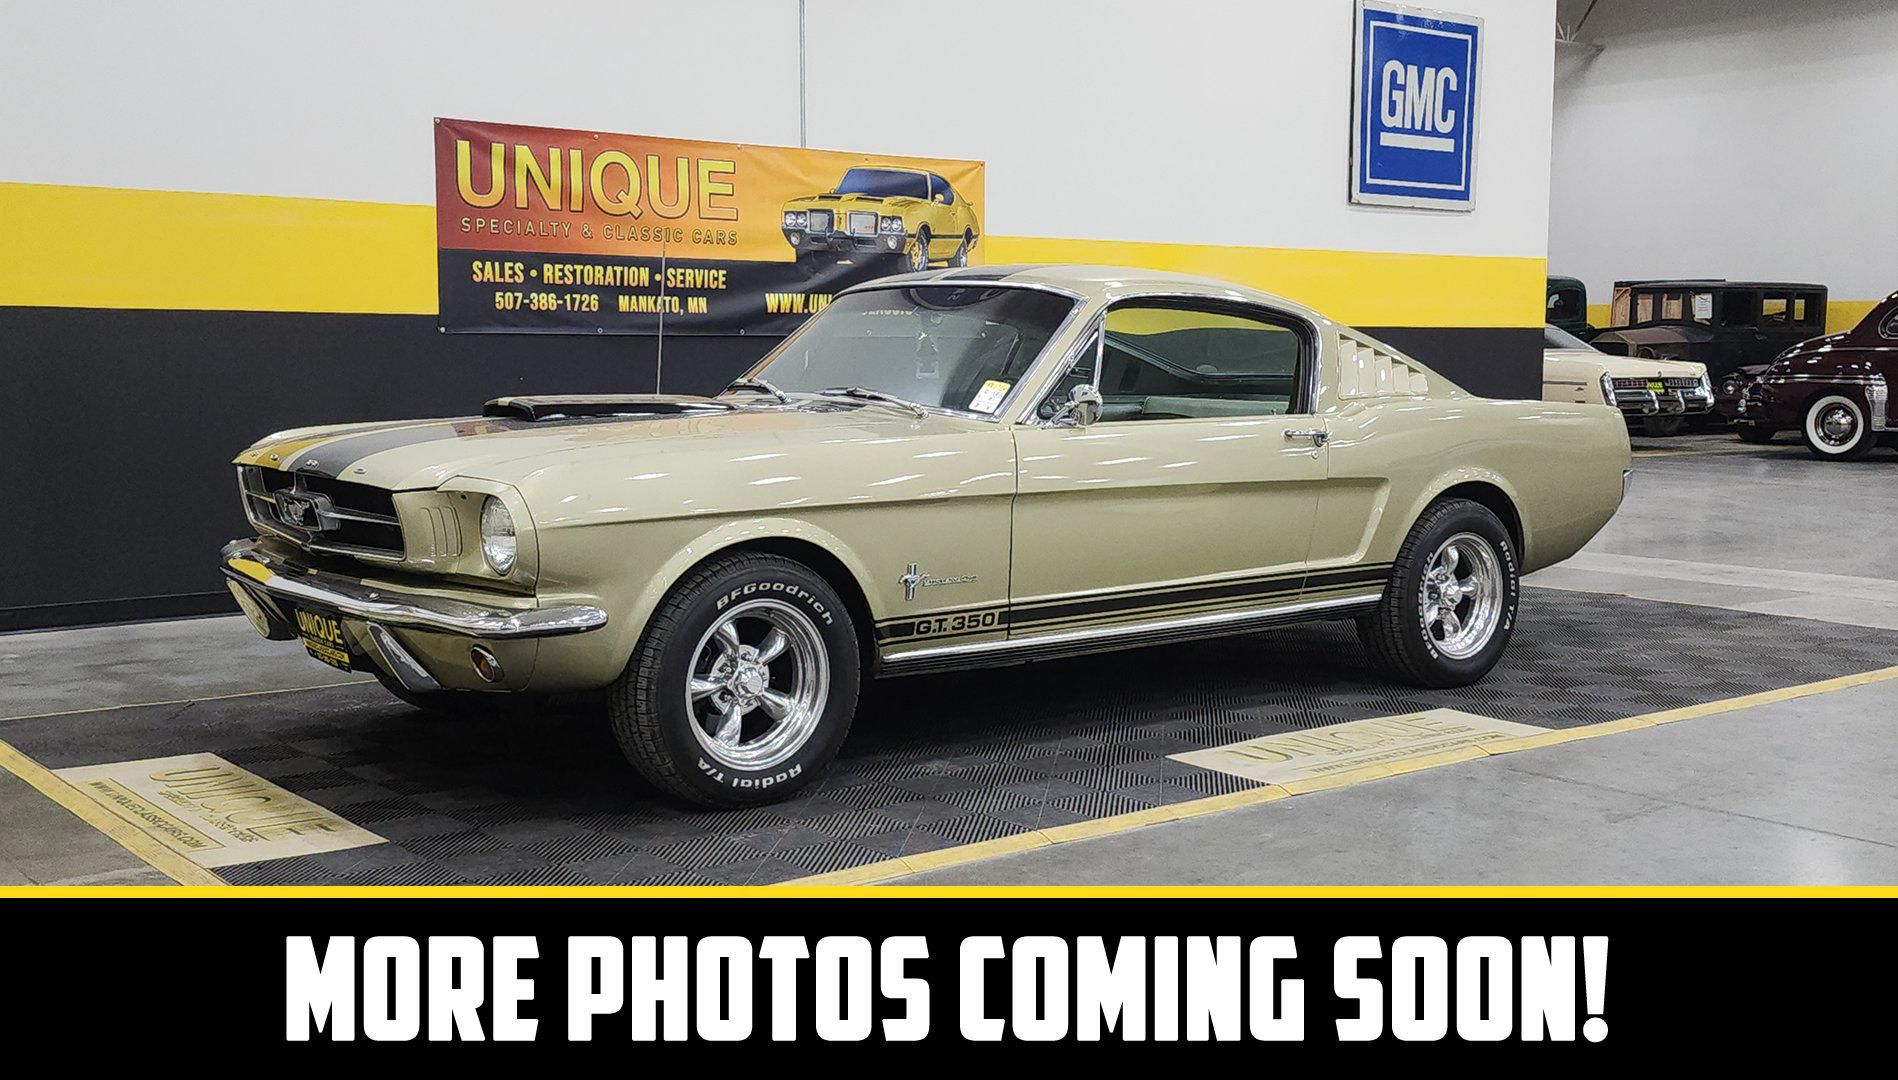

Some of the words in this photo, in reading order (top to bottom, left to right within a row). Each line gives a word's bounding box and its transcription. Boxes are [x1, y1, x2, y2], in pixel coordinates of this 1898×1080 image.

[1381, 60, 1458, 134] GMC
[455, 138, 740, 221] UNIQUE
[461, 217, 572, 239] SPECIALTY
[581, 222, 594, 240] &
[603, 225, 684, 243] CLASSIC
[691, 228, 738, 246] CARS
[472, 261, 525, 284] SALES
[543, 263, 650, 288] RESTORATION
[666, 268, 728, 290] SERVICE
[494, 291, 600, 312] 507-386-1726
[618, 294, 684, 316] MANKATO,
[687, 296, 708, 314] MN
[1499, 540, 1516, 597] Radial
[716, 581, 834, 627] BFGoodrich
[295, 608, 343, 644] UNIQUE
[916, 617, 948, 636] G.T.
[952, 612, 996, 631] 350
[697, 757, 725, 783] T/A
[731, 763, 803, 789] Radial
